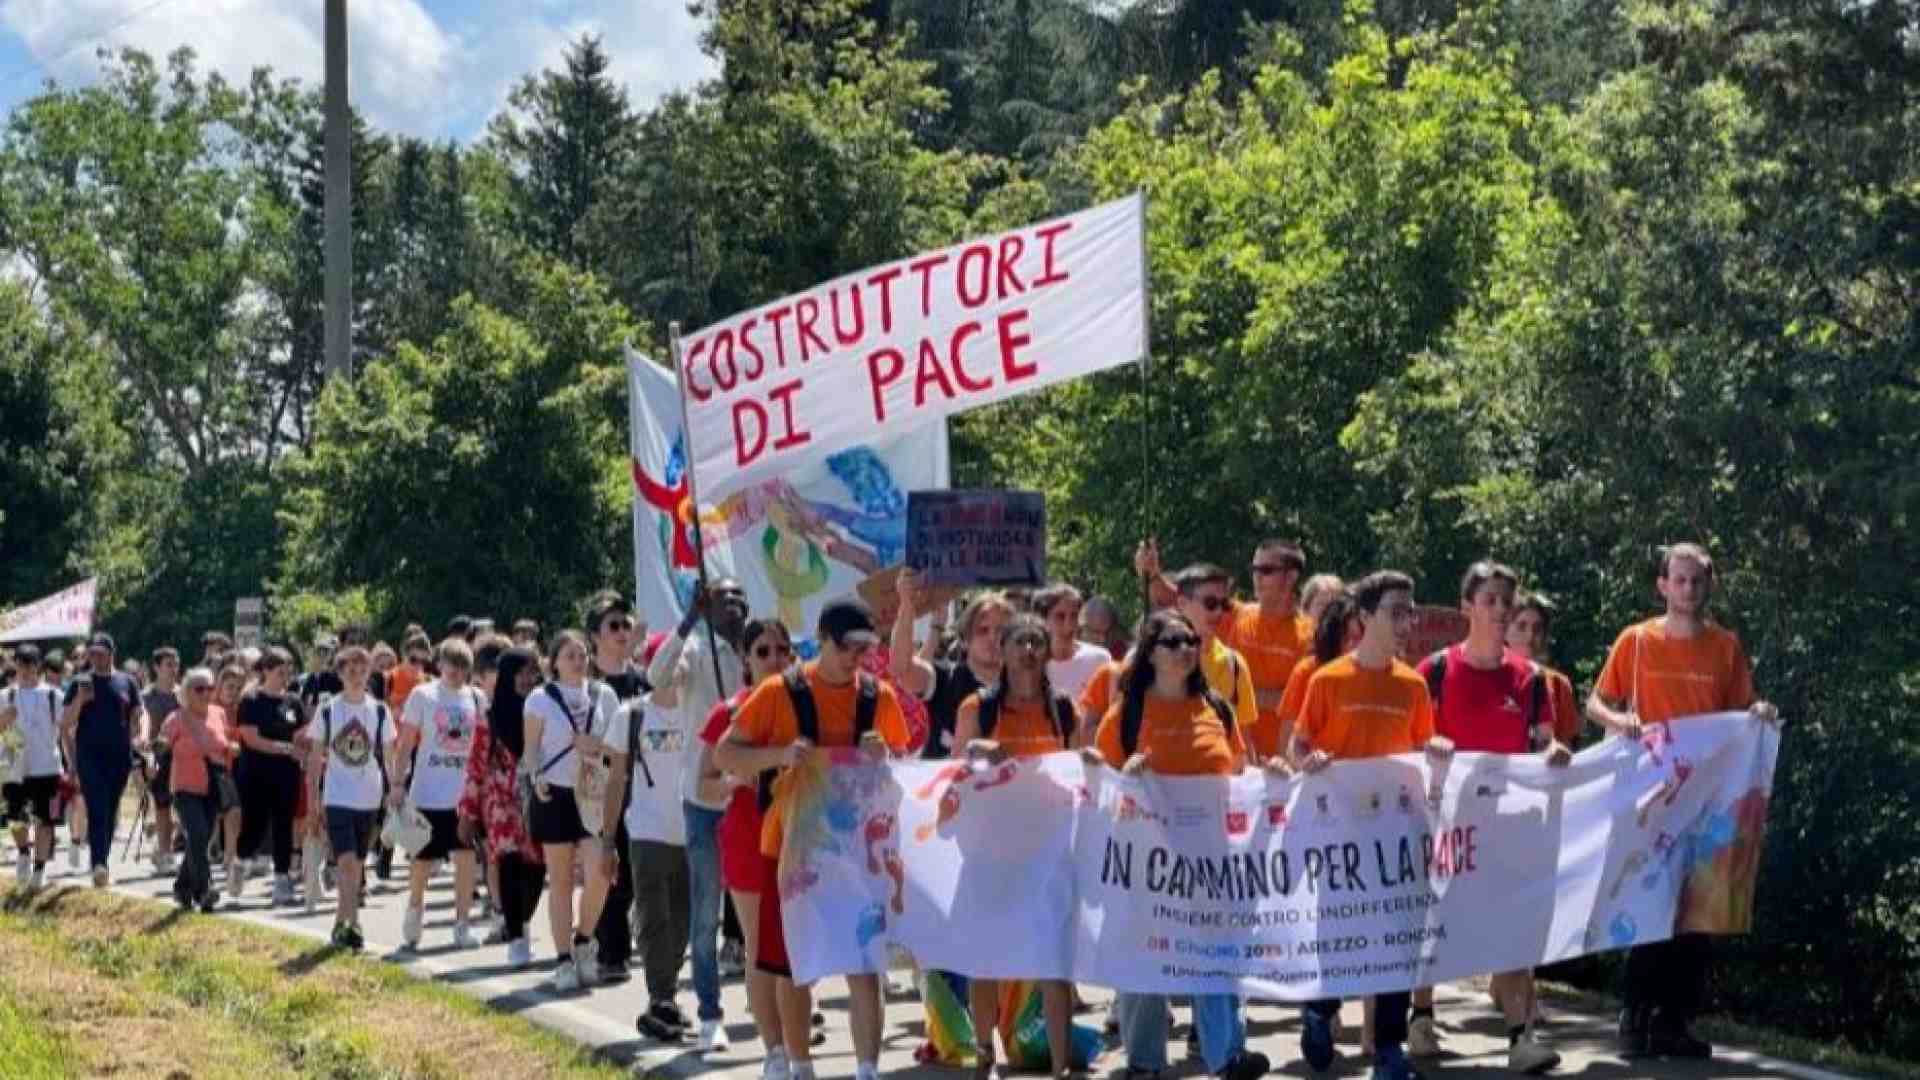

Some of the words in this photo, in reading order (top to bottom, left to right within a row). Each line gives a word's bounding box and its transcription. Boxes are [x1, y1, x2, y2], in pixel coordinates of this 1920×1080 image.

[684, 222, 1074, 402] COSTRUTTORI
[731, 380, 811, 467] DI
[867, 309, 1039, 424] PACE
[1101, 836, 1133, 892] IN
[1304, 841, 1367, 894] PER
[1374, 835, 1416, 888] LA
[1422, 825, 1477, 882] PACE
